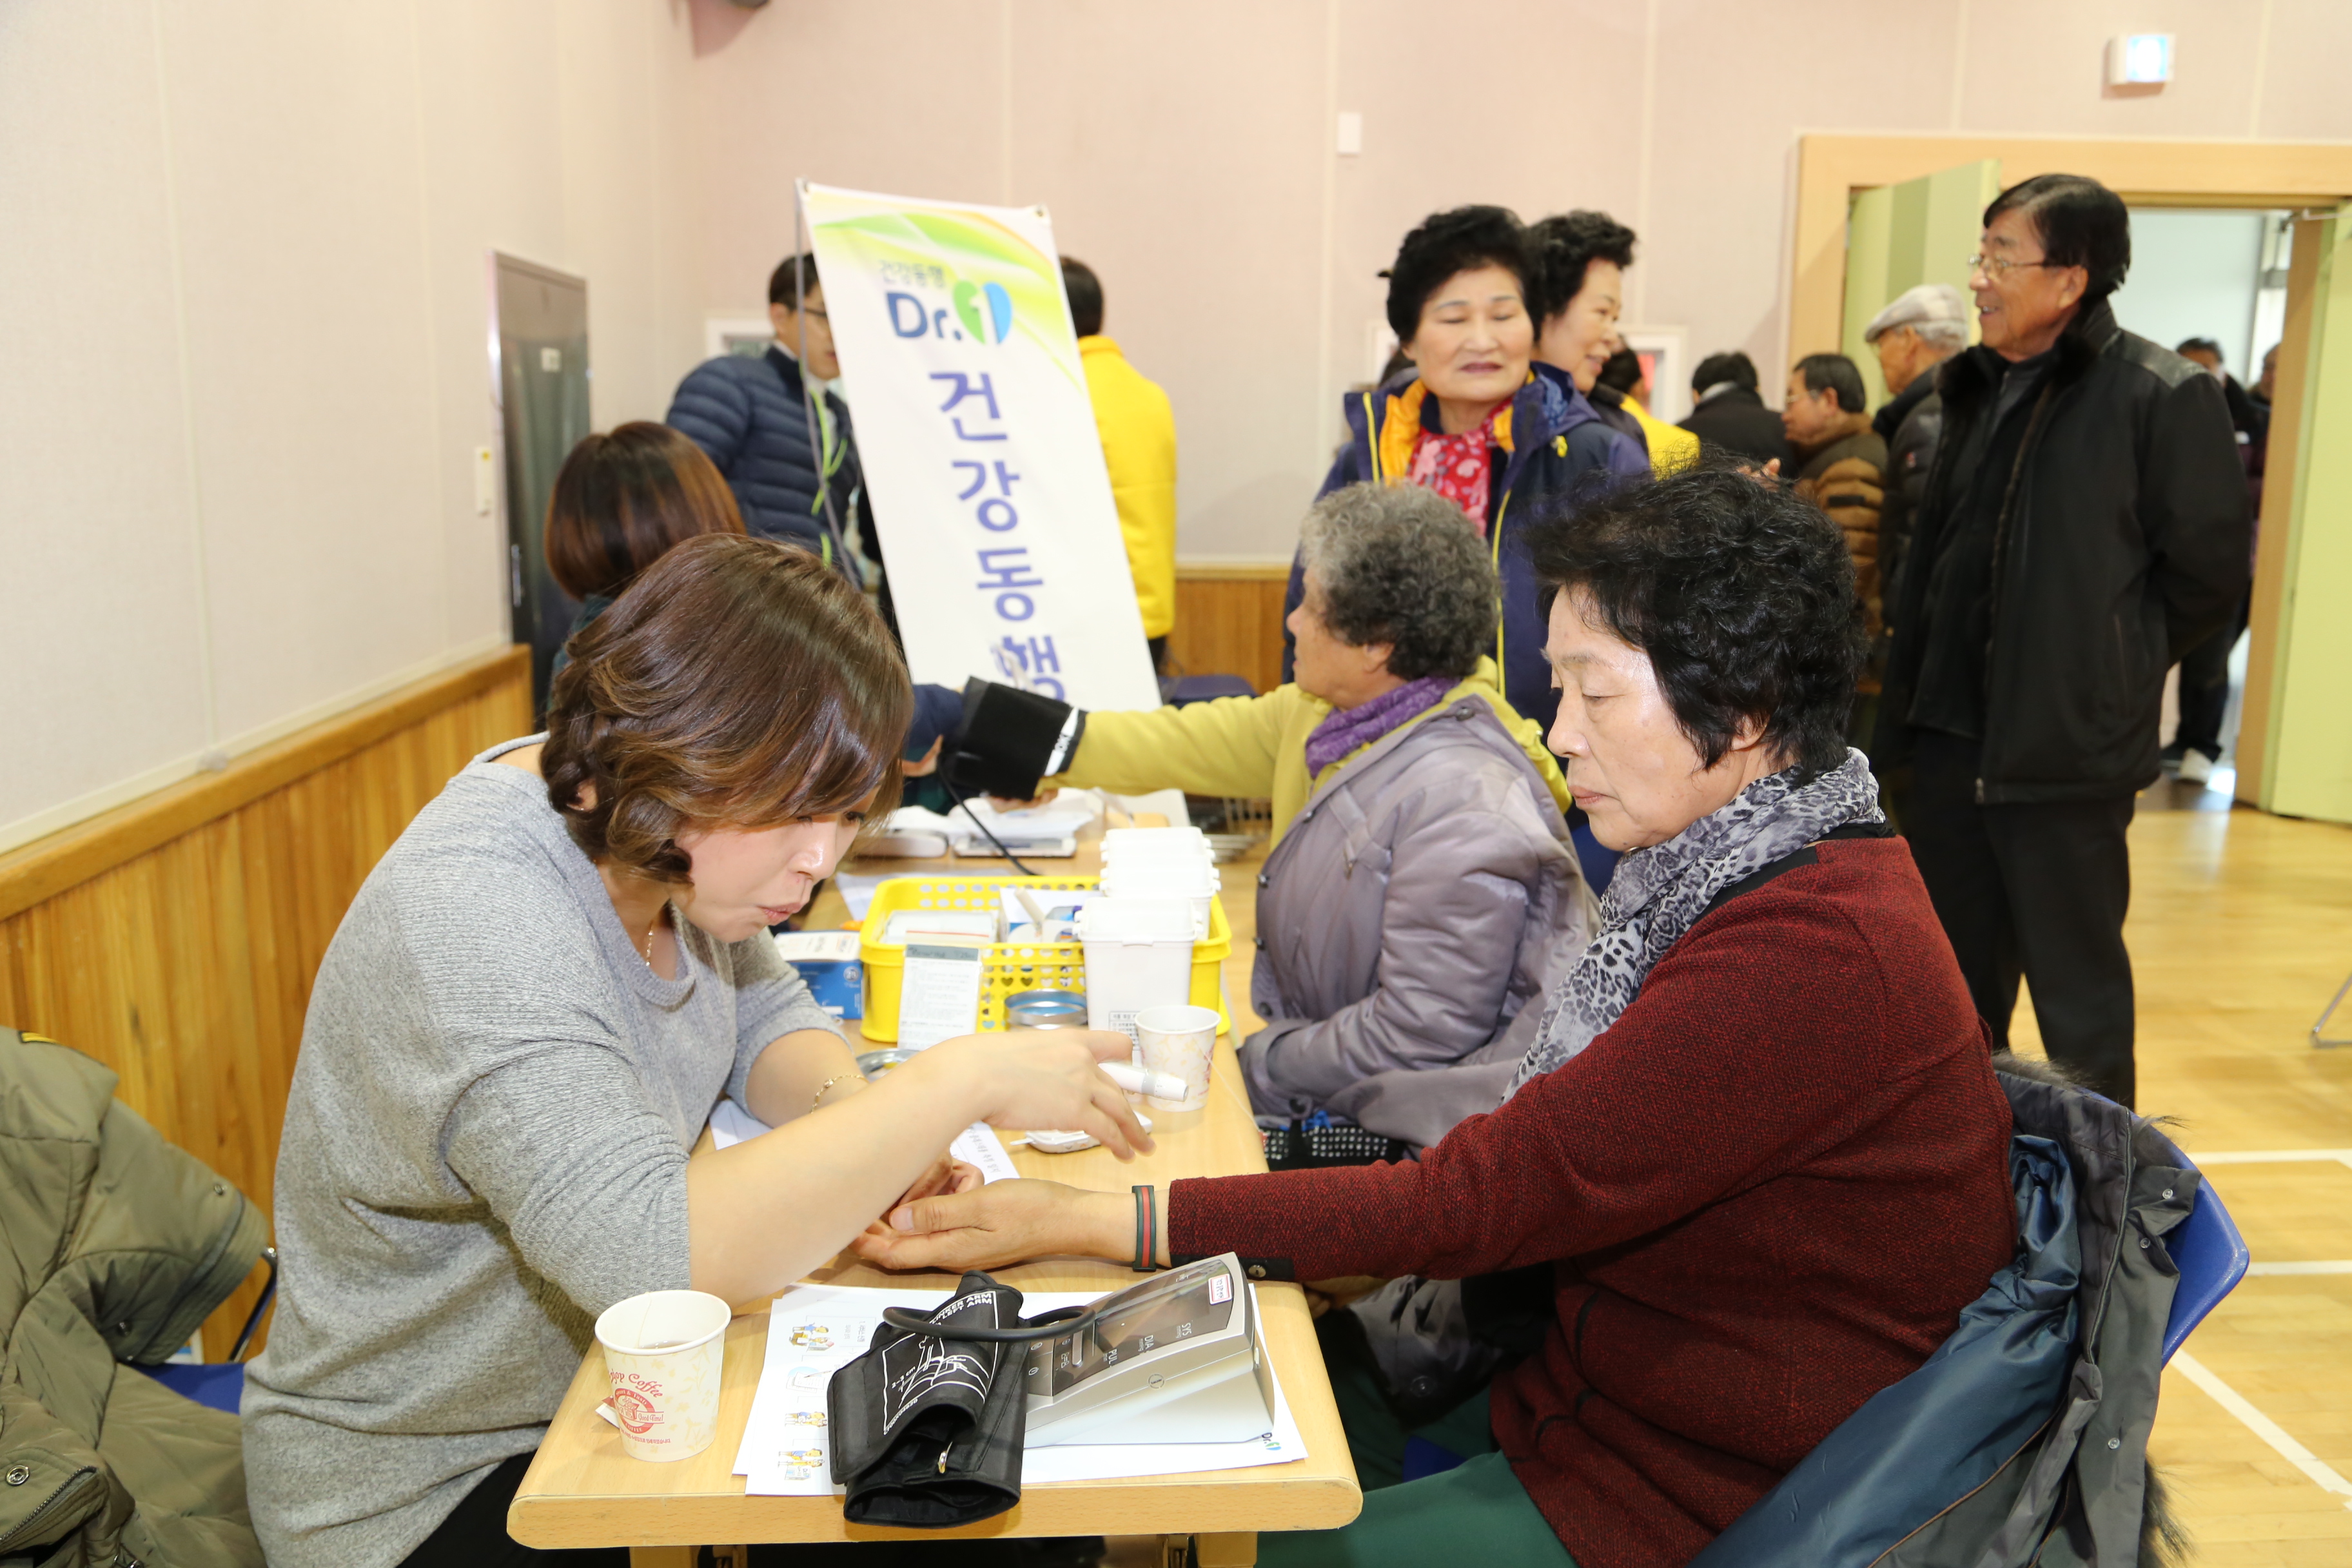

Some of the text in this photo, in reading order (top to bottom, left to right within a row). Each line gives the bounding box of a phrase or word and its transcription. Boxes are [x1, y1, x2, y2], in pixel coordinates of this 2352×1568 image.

[966, 1293, 992, 1303] ARM
[943, 1298, 992, 1320] LEFT ARM
[1181, 1322, 1192, 1336] SYS
[1144, 1335, 1154, 1349] DIA
[1108, 1348, 1118, 1365] PUL
[905, 1366, 916, 1377] cm
[629, 1373, 663, 1398] Coffee
[638, 1413, 649, 1421] Good
